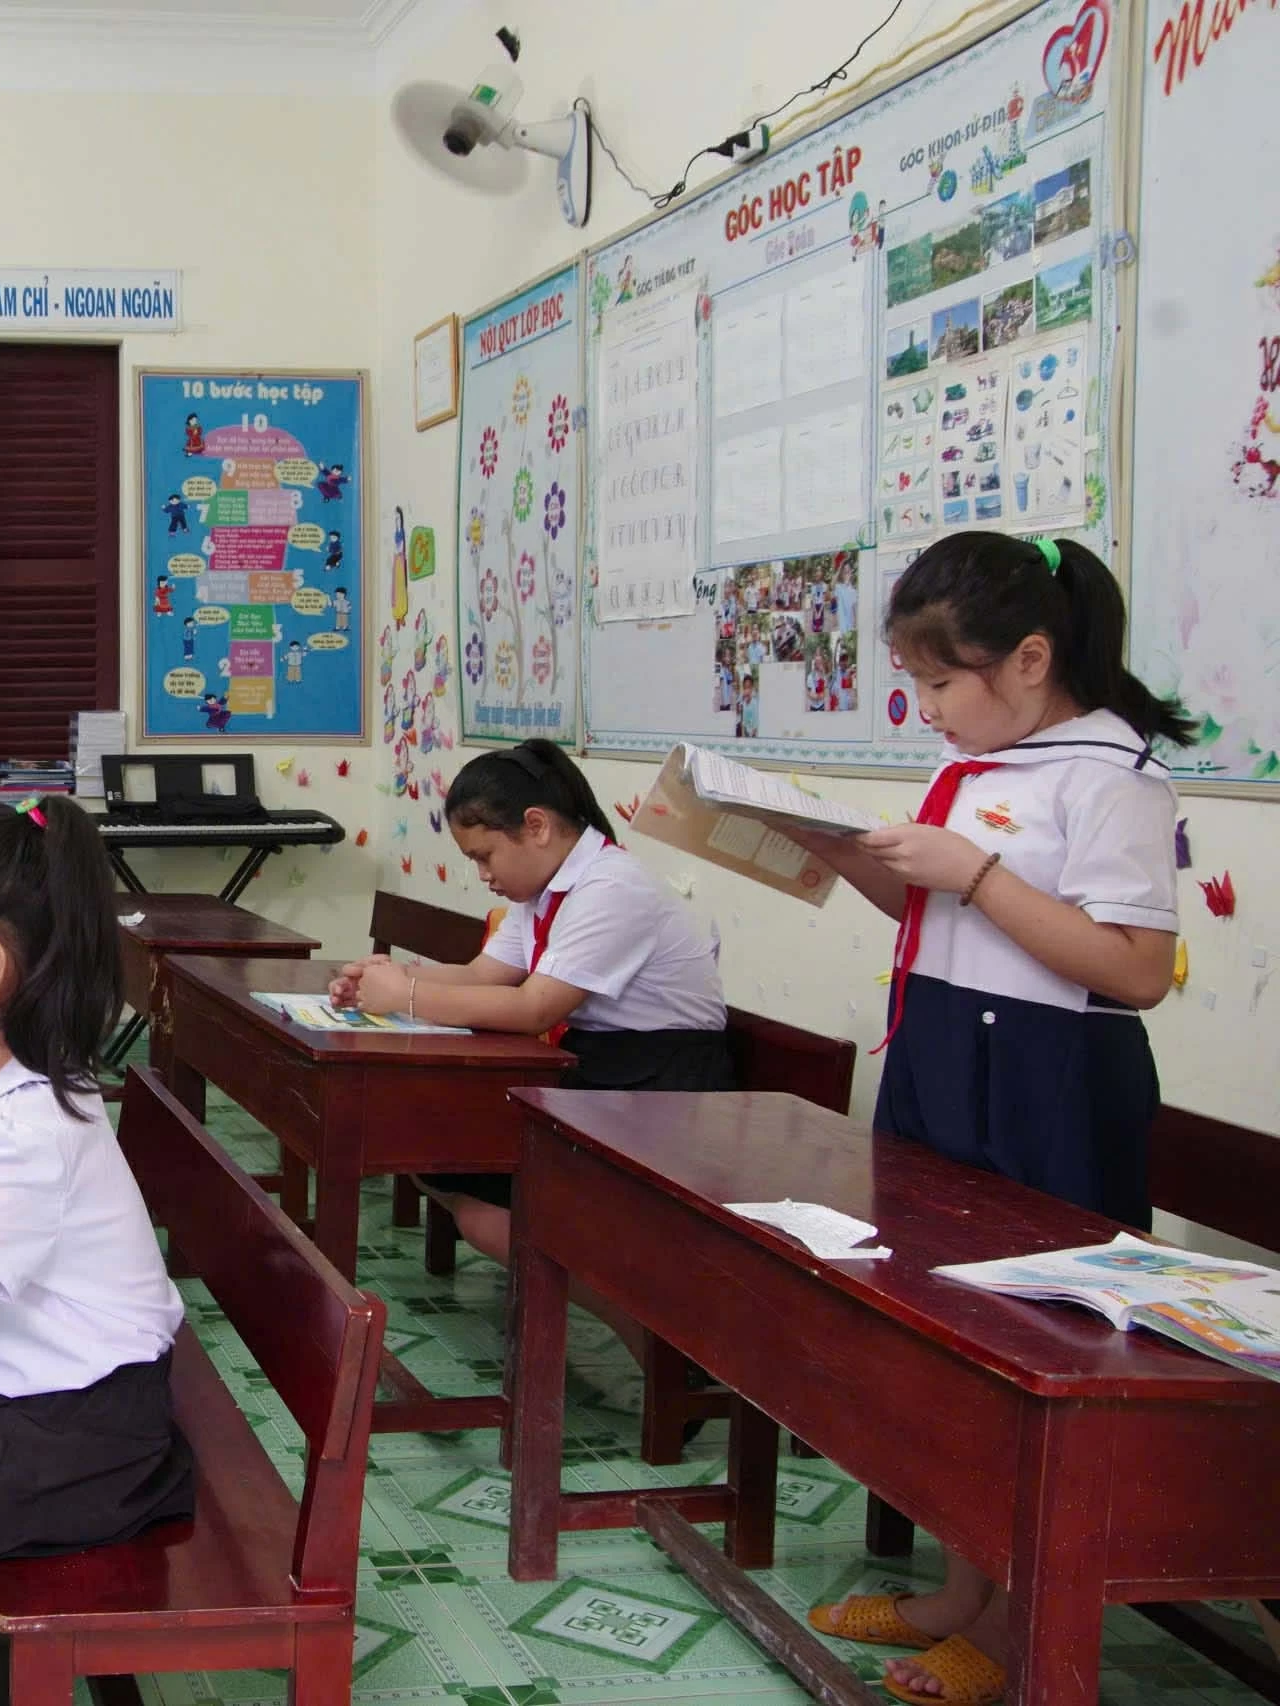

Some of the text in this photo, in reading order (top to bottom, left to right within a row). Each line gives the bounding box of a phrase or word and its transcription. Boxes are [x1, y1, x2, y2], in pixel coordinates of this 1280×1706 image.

[725, 145, 862, 242] GÓC HỌC TẬP
[22, 275, 49, 317] CHỈ
[64, 287, 116, 319] NGOAN
[121, 280, 174, 319] NGOÃN
[480, 322, 497, 360] NỘI
[498, 313, 520, 354] QUY
[520, 301, 540, 338] LỚP
[542, 292, 564, 330] HỌC
[182, 381, 324, 406] 10 bước học tập
[241, 413, 269, 434] 10
[196, 503, 211, 524] 7
[218, 658, 231, 678] 2
